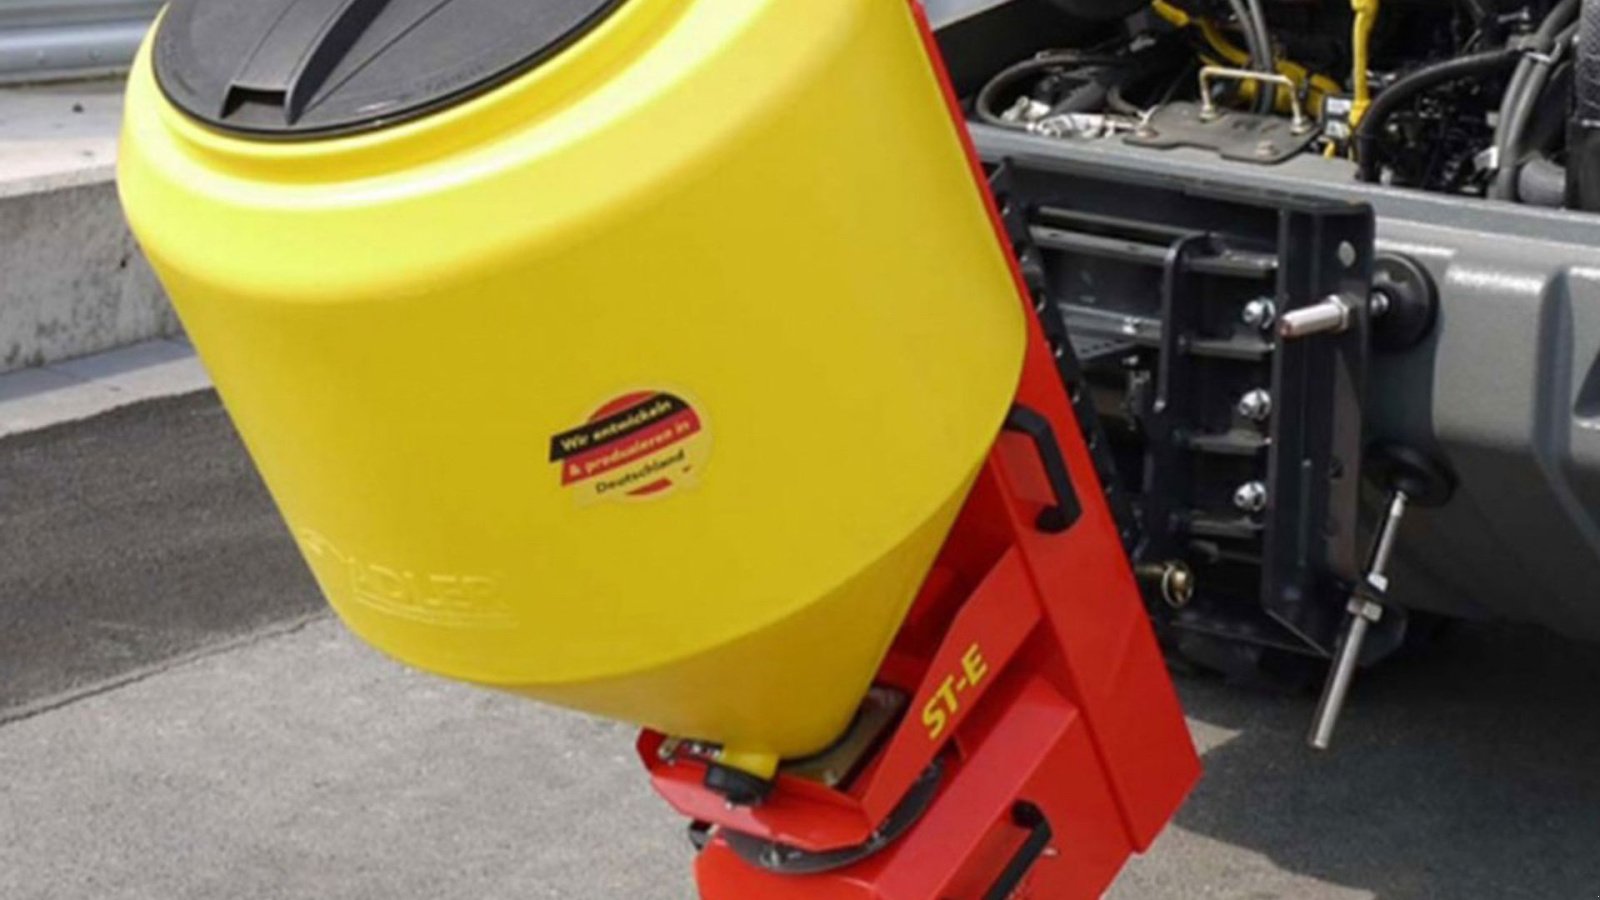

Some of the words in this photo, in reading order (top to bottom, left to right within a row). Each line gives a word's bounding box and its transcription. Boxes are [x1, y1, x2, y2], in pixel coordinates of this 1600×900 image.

[560, 433, 590, 451] Wir
[592, 400, 673, 440] entwickeln
[568, 463, 582, 477] &
[584, 429, 673, 475] produzieren
[675, 420, 691, 435] in
[595, 448, 685, 494] Deutschland
[922, 642, 989, 740] ST-E
